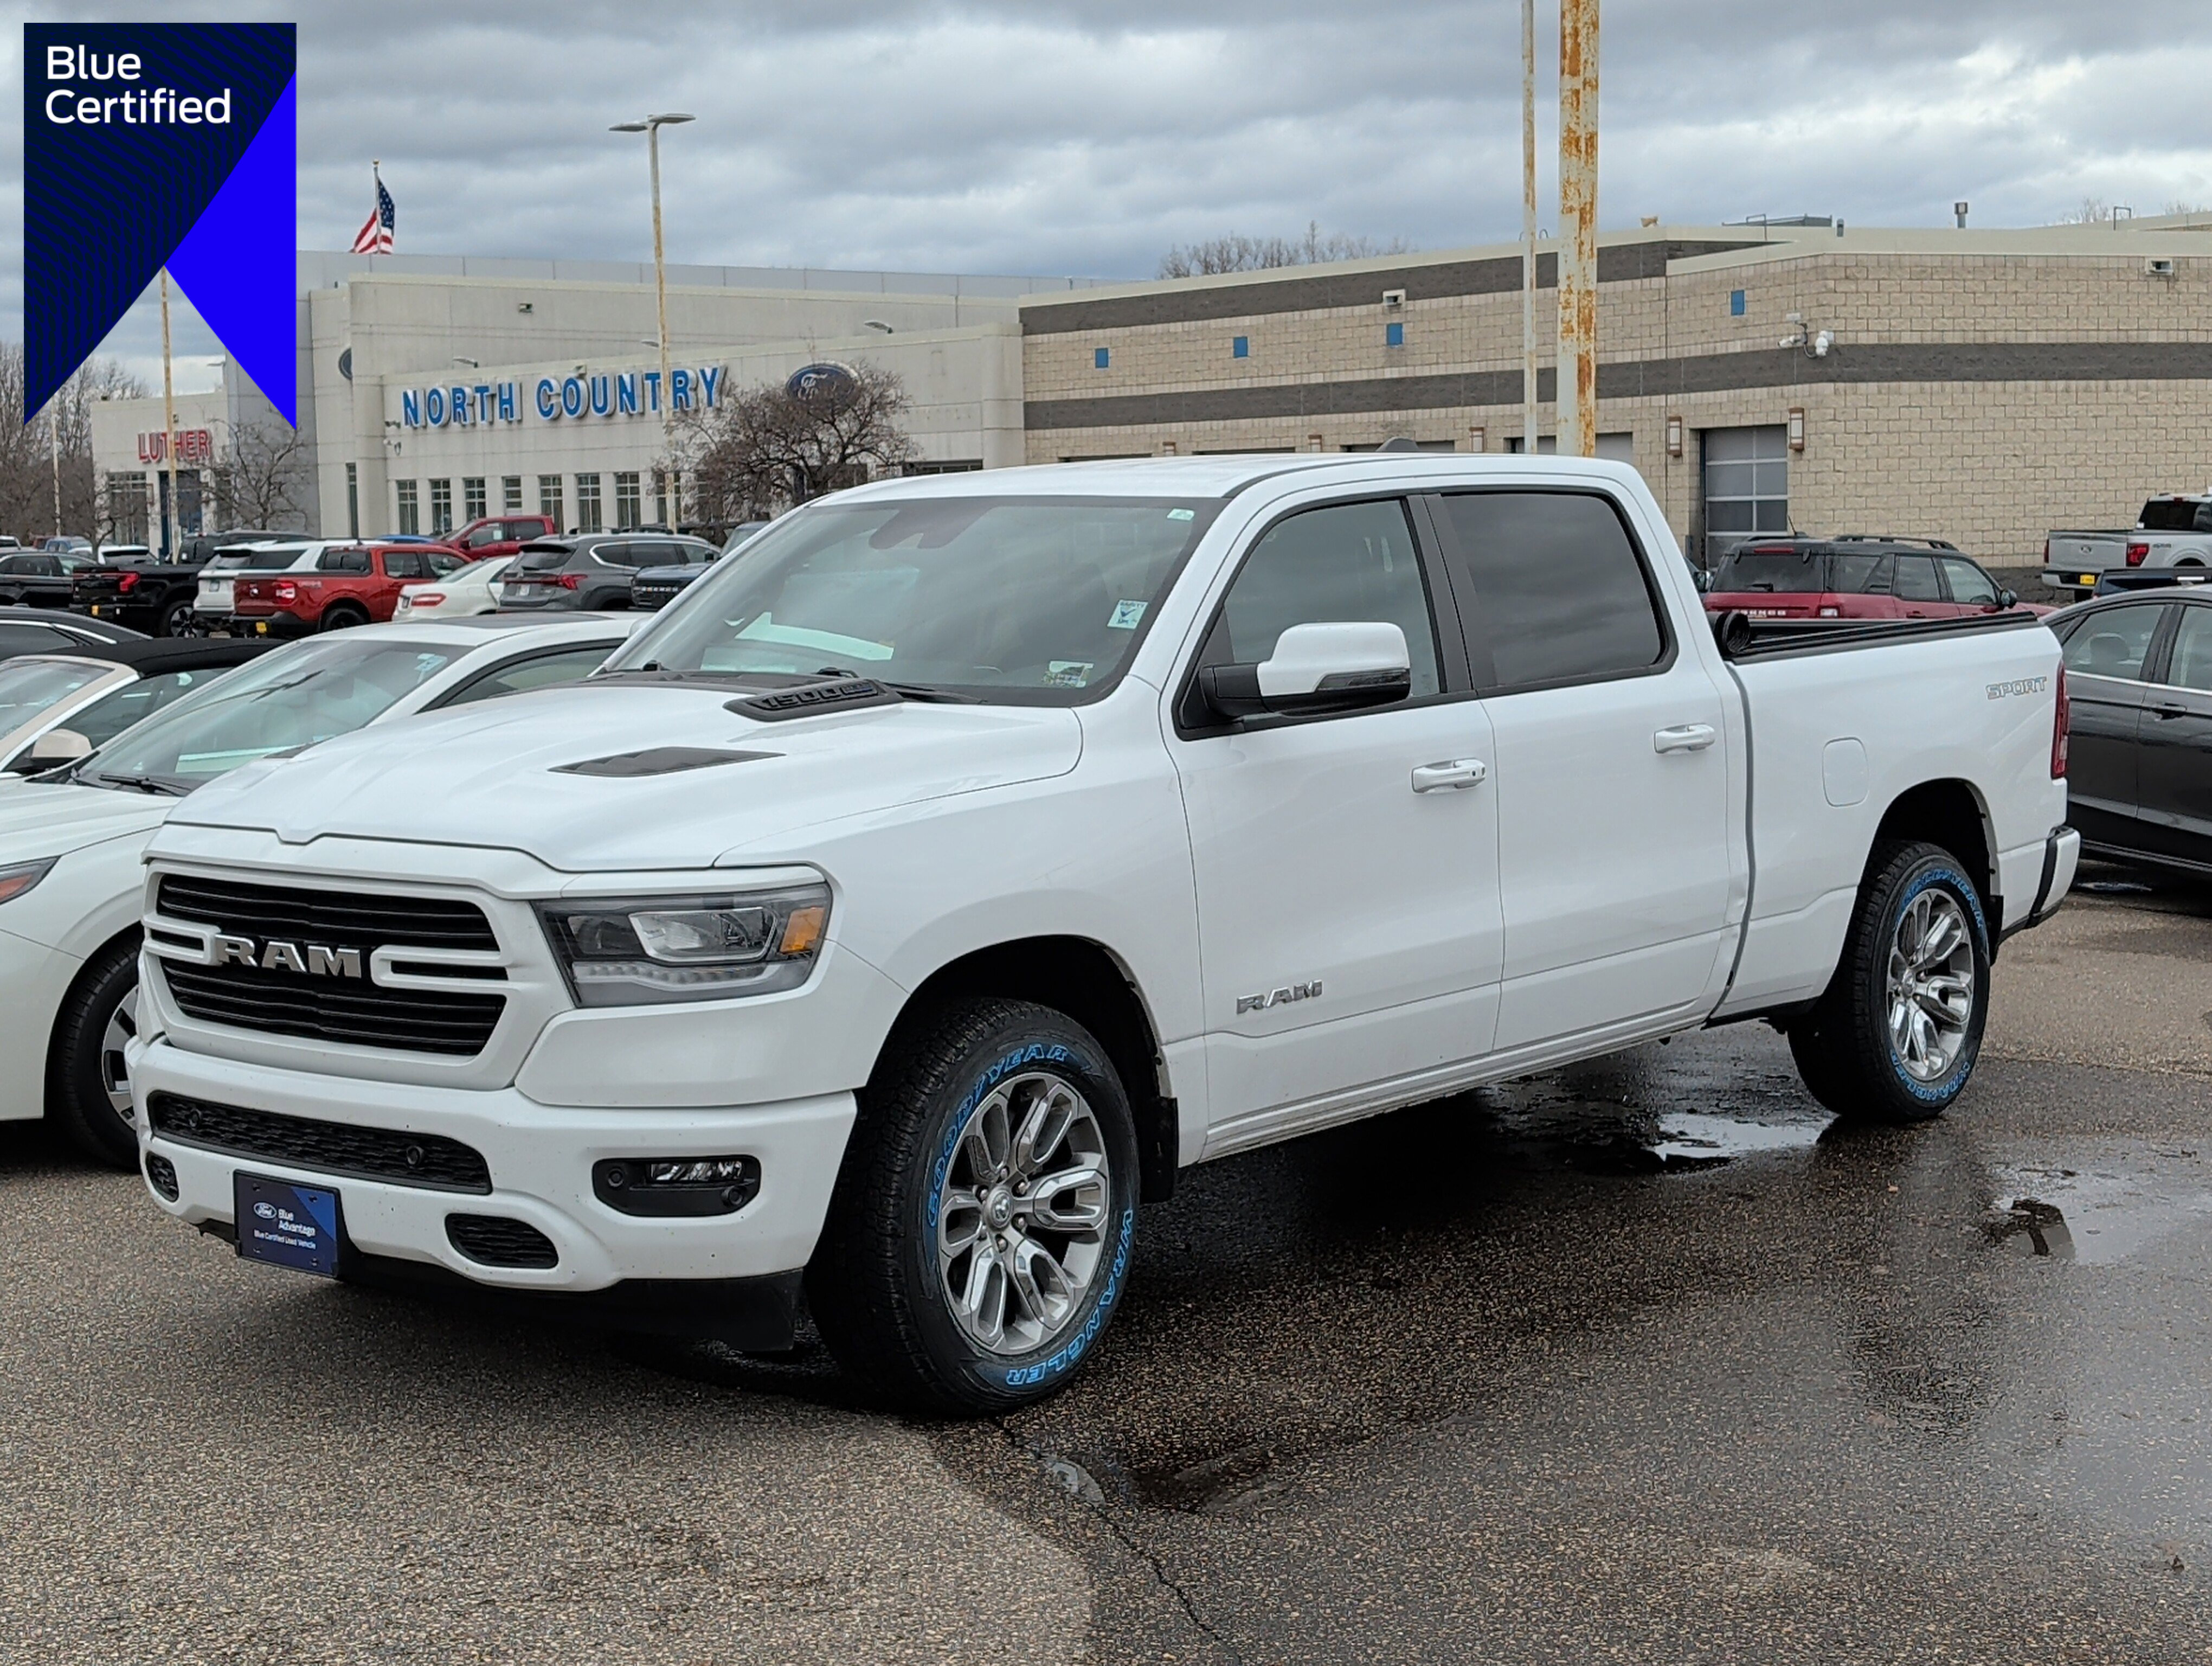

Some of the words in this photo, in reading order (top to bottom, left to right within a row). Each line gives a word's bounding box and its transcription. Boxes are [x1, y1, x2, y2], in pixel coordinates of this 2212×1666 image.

[402, 381, 519, 428] NORTH
[536, 366, 723, 420] COUNTRY
[137, 430, 211, 463] LUTHER
[762, 685, 841, 707] 1500
[1985, 676, 2047, 700] SPORT
[215, 934, 362, 978] RAM
[1237, 979, 1323, 1015] RAM
[928, 1043, 1069, 1227] GOODYEAR
[278, 1208, 294, 1221] Blue
[278, 1220, 316, 1237] Advantage
[1006, 1209, 1133, 1385] WRANGLER
